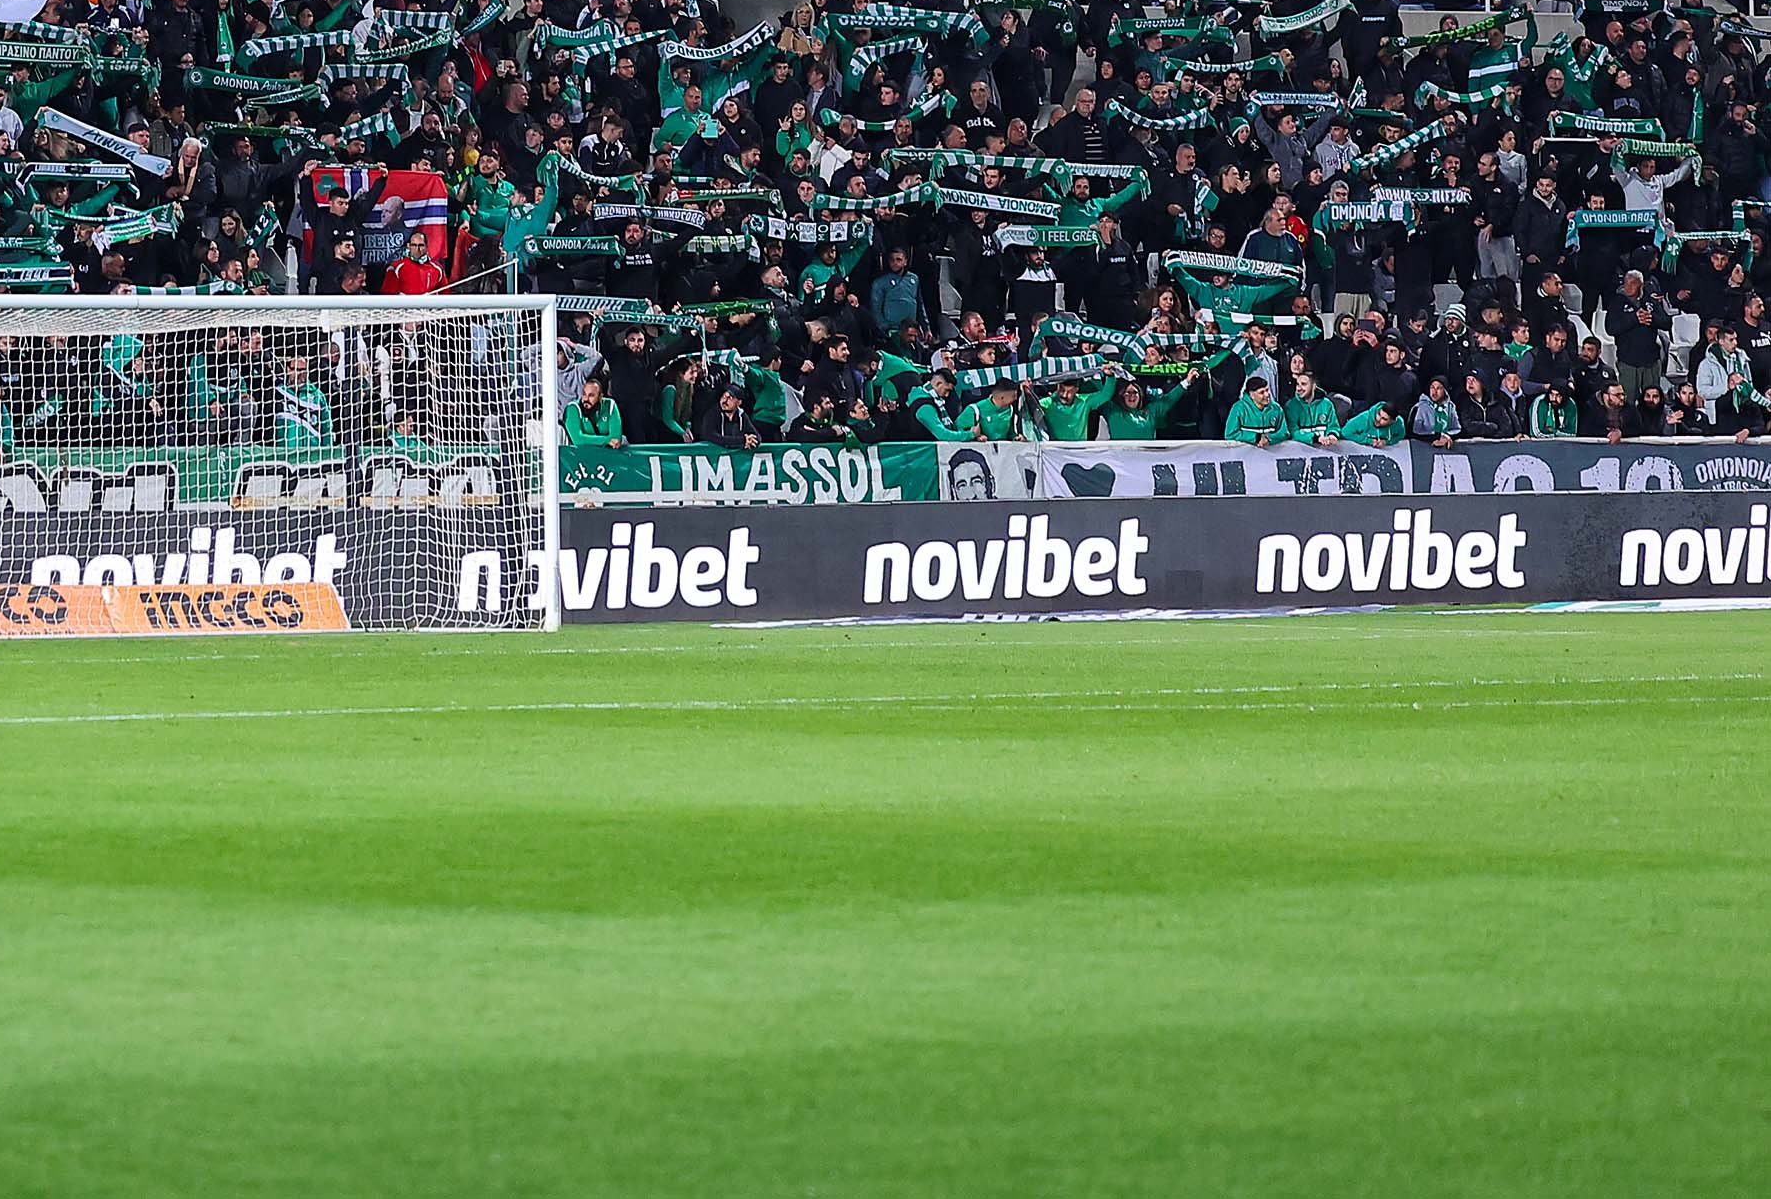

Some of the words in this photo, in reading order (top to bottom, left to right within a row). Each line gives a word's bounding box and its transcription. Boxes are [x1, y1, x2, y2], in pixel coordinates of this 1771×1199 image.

[838, 14, 916, 28] OMONOIA
[37, 46, 79, 60] ΠΑΝΤΟΥ
[676, 43, 732, 59] OMONOIA
[212, 75, 259, 92] OMONOIA
[1574, 117, 1637, 133] OMONOIA
[1330, 204, 1386, 223] OMONOIA
[1582, 212, 1628, 223] OMONOIA
[1040, 230, 1045, 242] I
[1046, 231, 1070, 243] FEEL
[541, 240, 582, 251] OMONOIA
[649, 446, 902, 505] LIMASSOL
[1256, 508, 1526, 593] novibet
[1620, 504, 1771, 588] novi
[864, 514, 1149, 598] novibet
